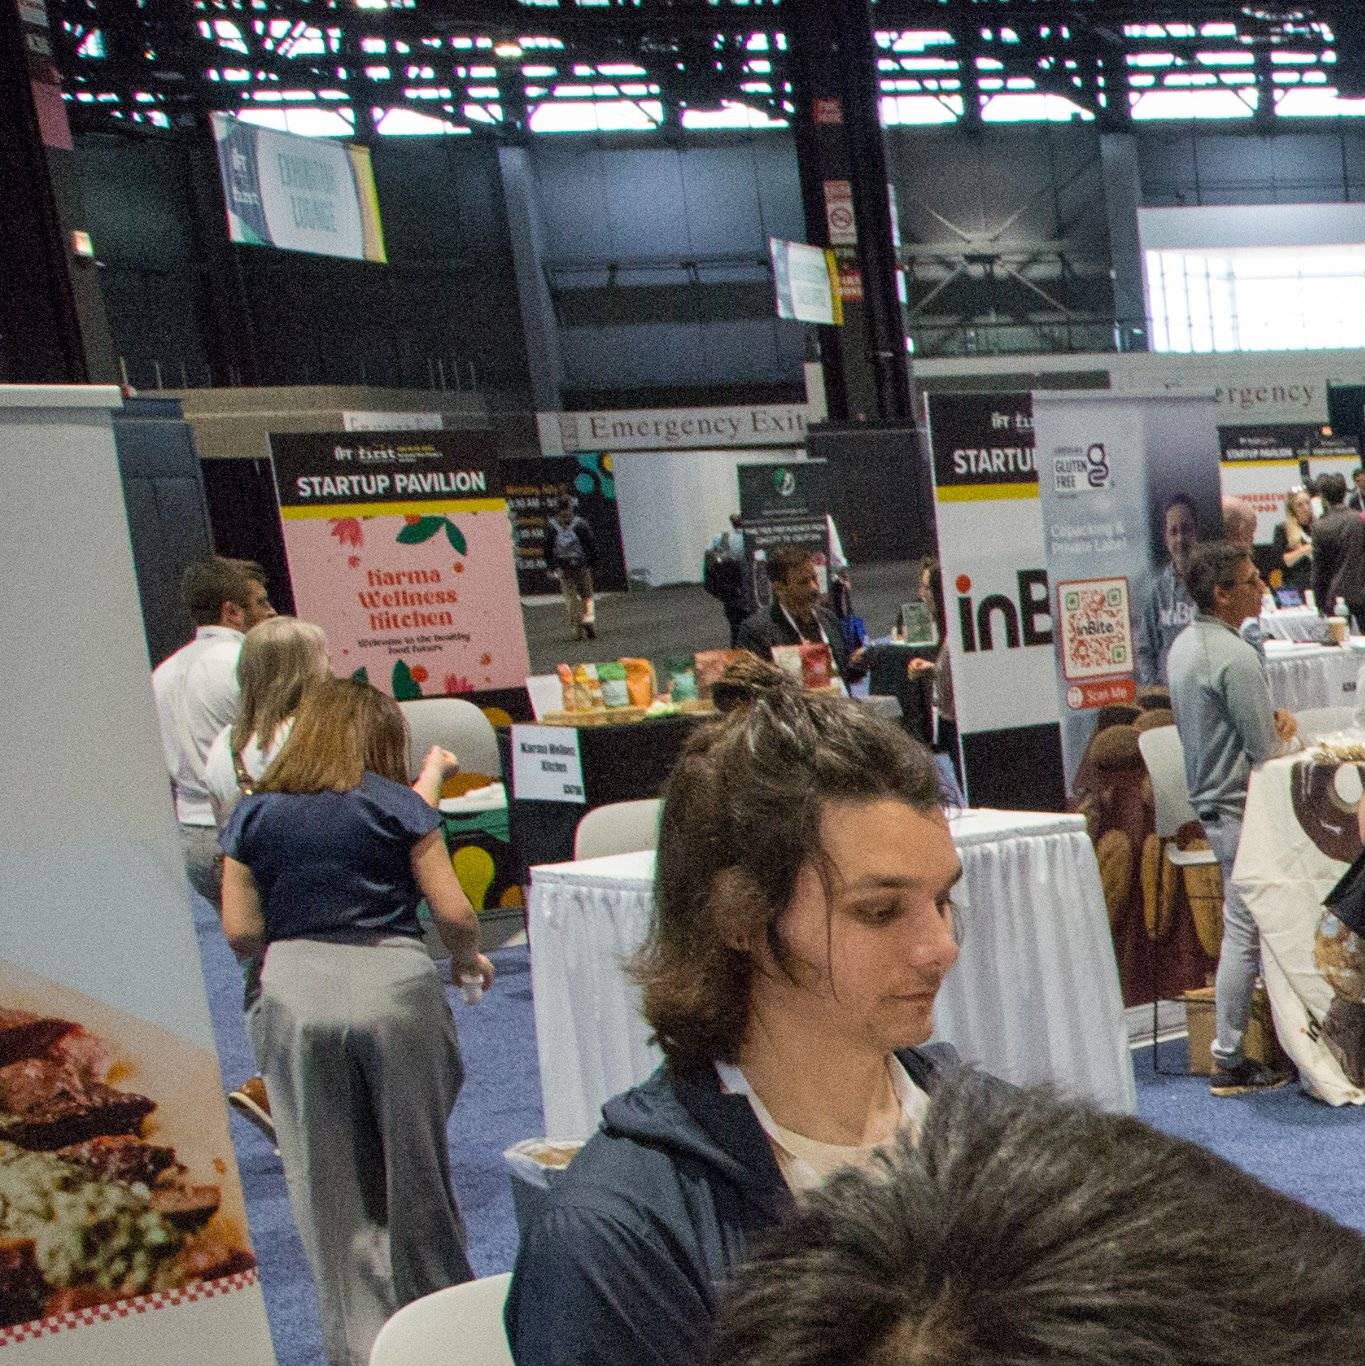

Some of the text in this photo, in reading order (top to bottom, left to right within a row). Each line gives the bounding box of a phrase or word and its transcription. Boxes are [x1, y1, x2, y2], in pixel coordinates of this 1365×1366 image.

[1214, 384, 1316, 410] ergency
[590, 405, 804, 442] Emergency Exit
[953, 447, 1037, 476] STARTU
[1055, 459, 1089, 473] GLUTEN
[297, 471, 487, 498] STARTUP PAVILION
[1056, 474, 1076, 488] FREE
[367, 568, 442, 587] Karma
[357, 588, 459, 609] Wellness
[368, 608, 454, 631] Kitchen
[956, 568, 1053, 653] inB
[1077, 620, 1114, 636] inBite
